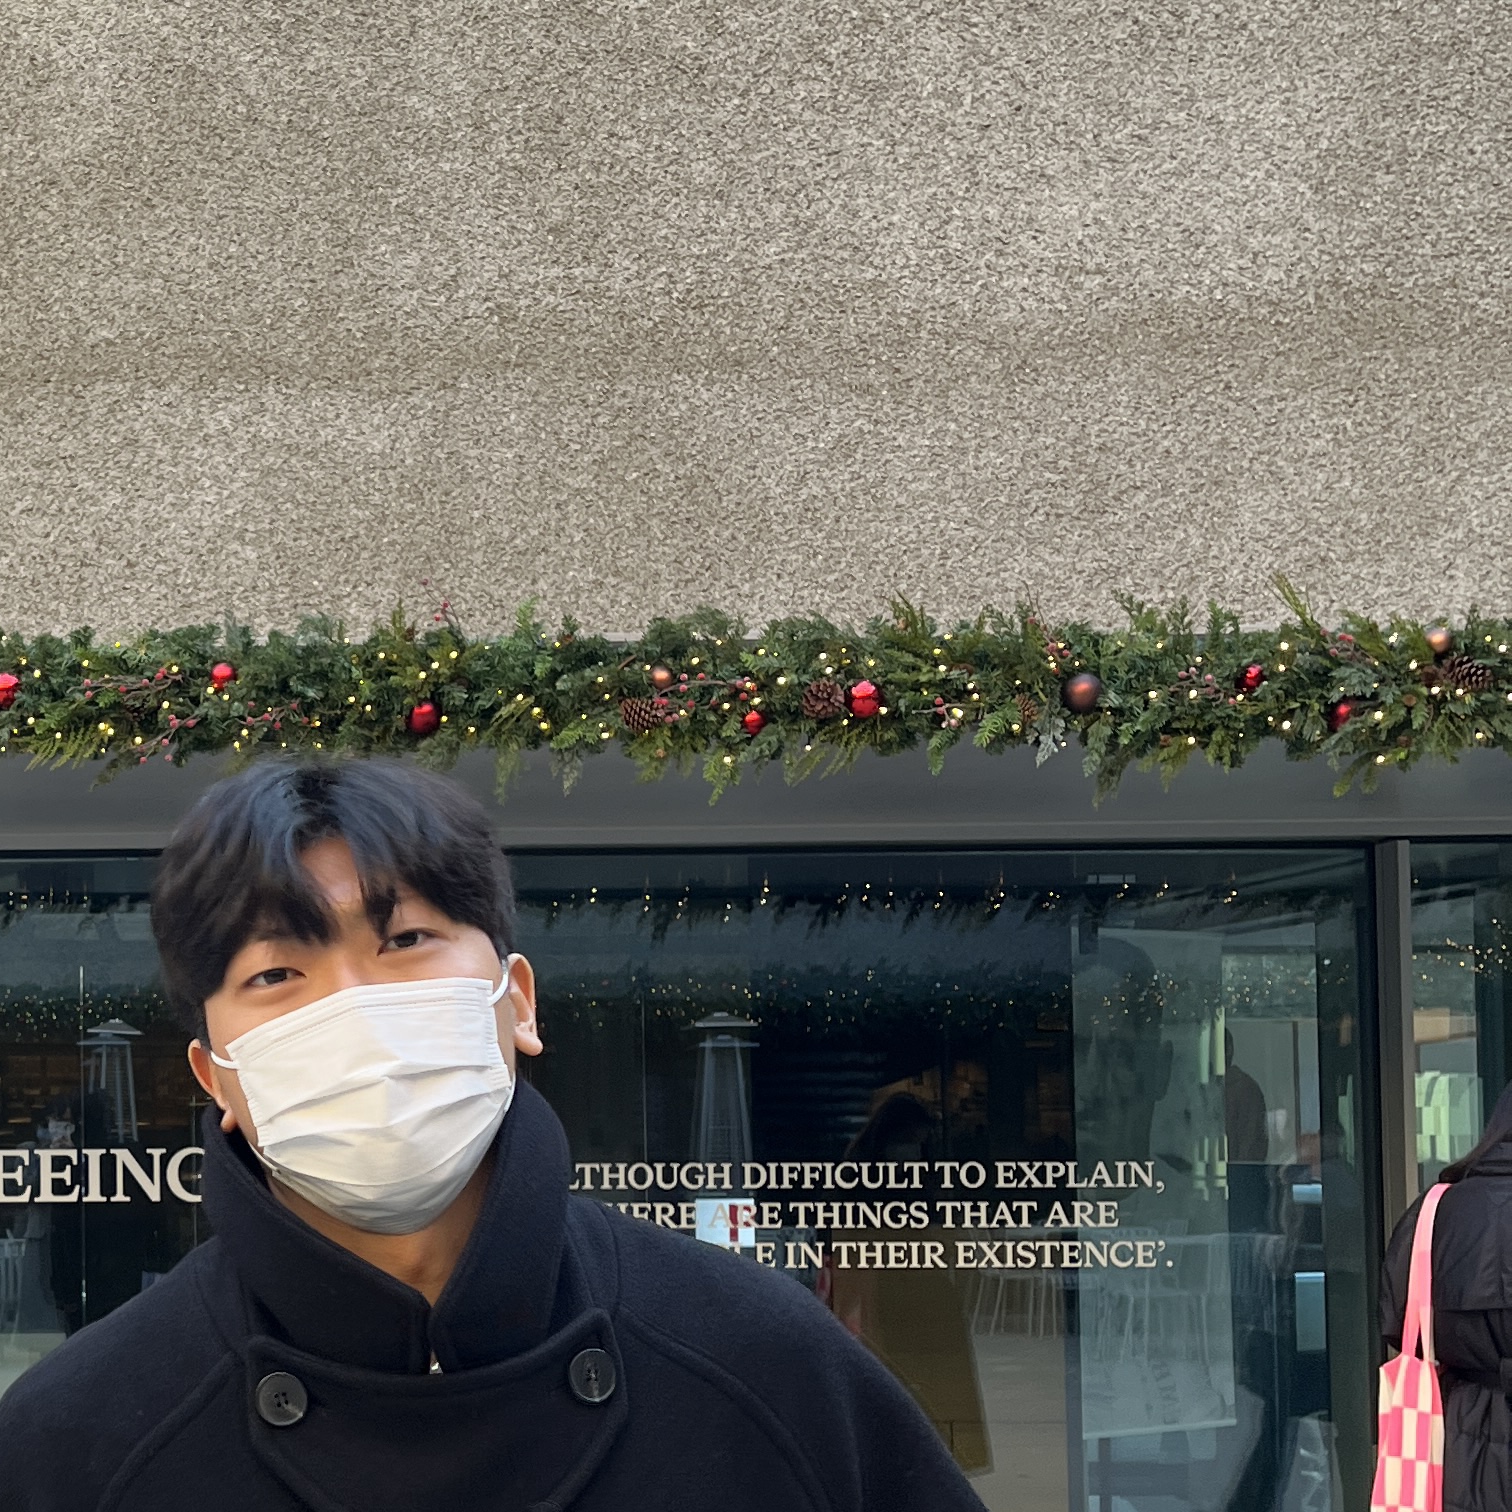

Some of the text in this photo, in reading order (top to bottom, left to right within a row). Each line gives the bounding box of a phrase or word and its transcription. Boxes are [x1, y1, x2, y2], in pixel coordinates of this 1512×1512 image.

[742, 1161, 929, 1190] DIFFICULT
[935, 1161, 986, 1189] TO
[995, 1161, 1165, 1193] EXPLAIN,
[709, 1202, 783, 1229] ARE
[789, 1201, 929, 1230] THINGS
[936, 1201, 1037, 1229] THAT
[1044, 1201, 1119, 1228] ARE
[785, 1241, 825, 1269] IN
[832, 1241, 948, 1269] THEIR
